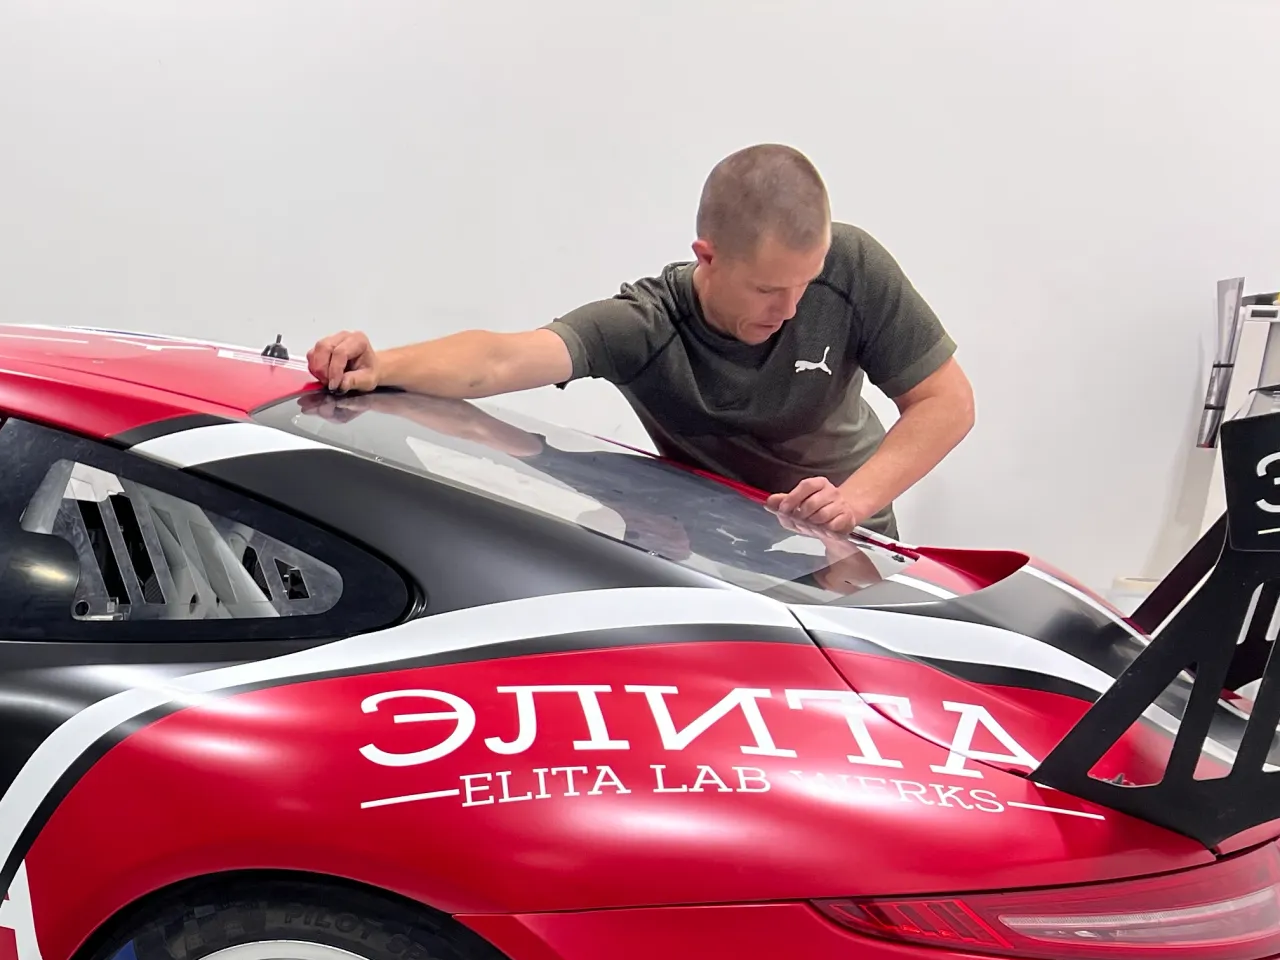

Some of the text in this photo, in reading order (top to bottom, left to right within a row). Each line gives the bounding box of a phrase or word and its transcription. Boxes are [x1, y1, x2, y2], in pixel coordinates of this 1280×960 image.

[358, 684, 1042, 779] ЭЛИТА
[459, 764, 632, 808] ELITA
[650, 764, 772, 793] LAB
